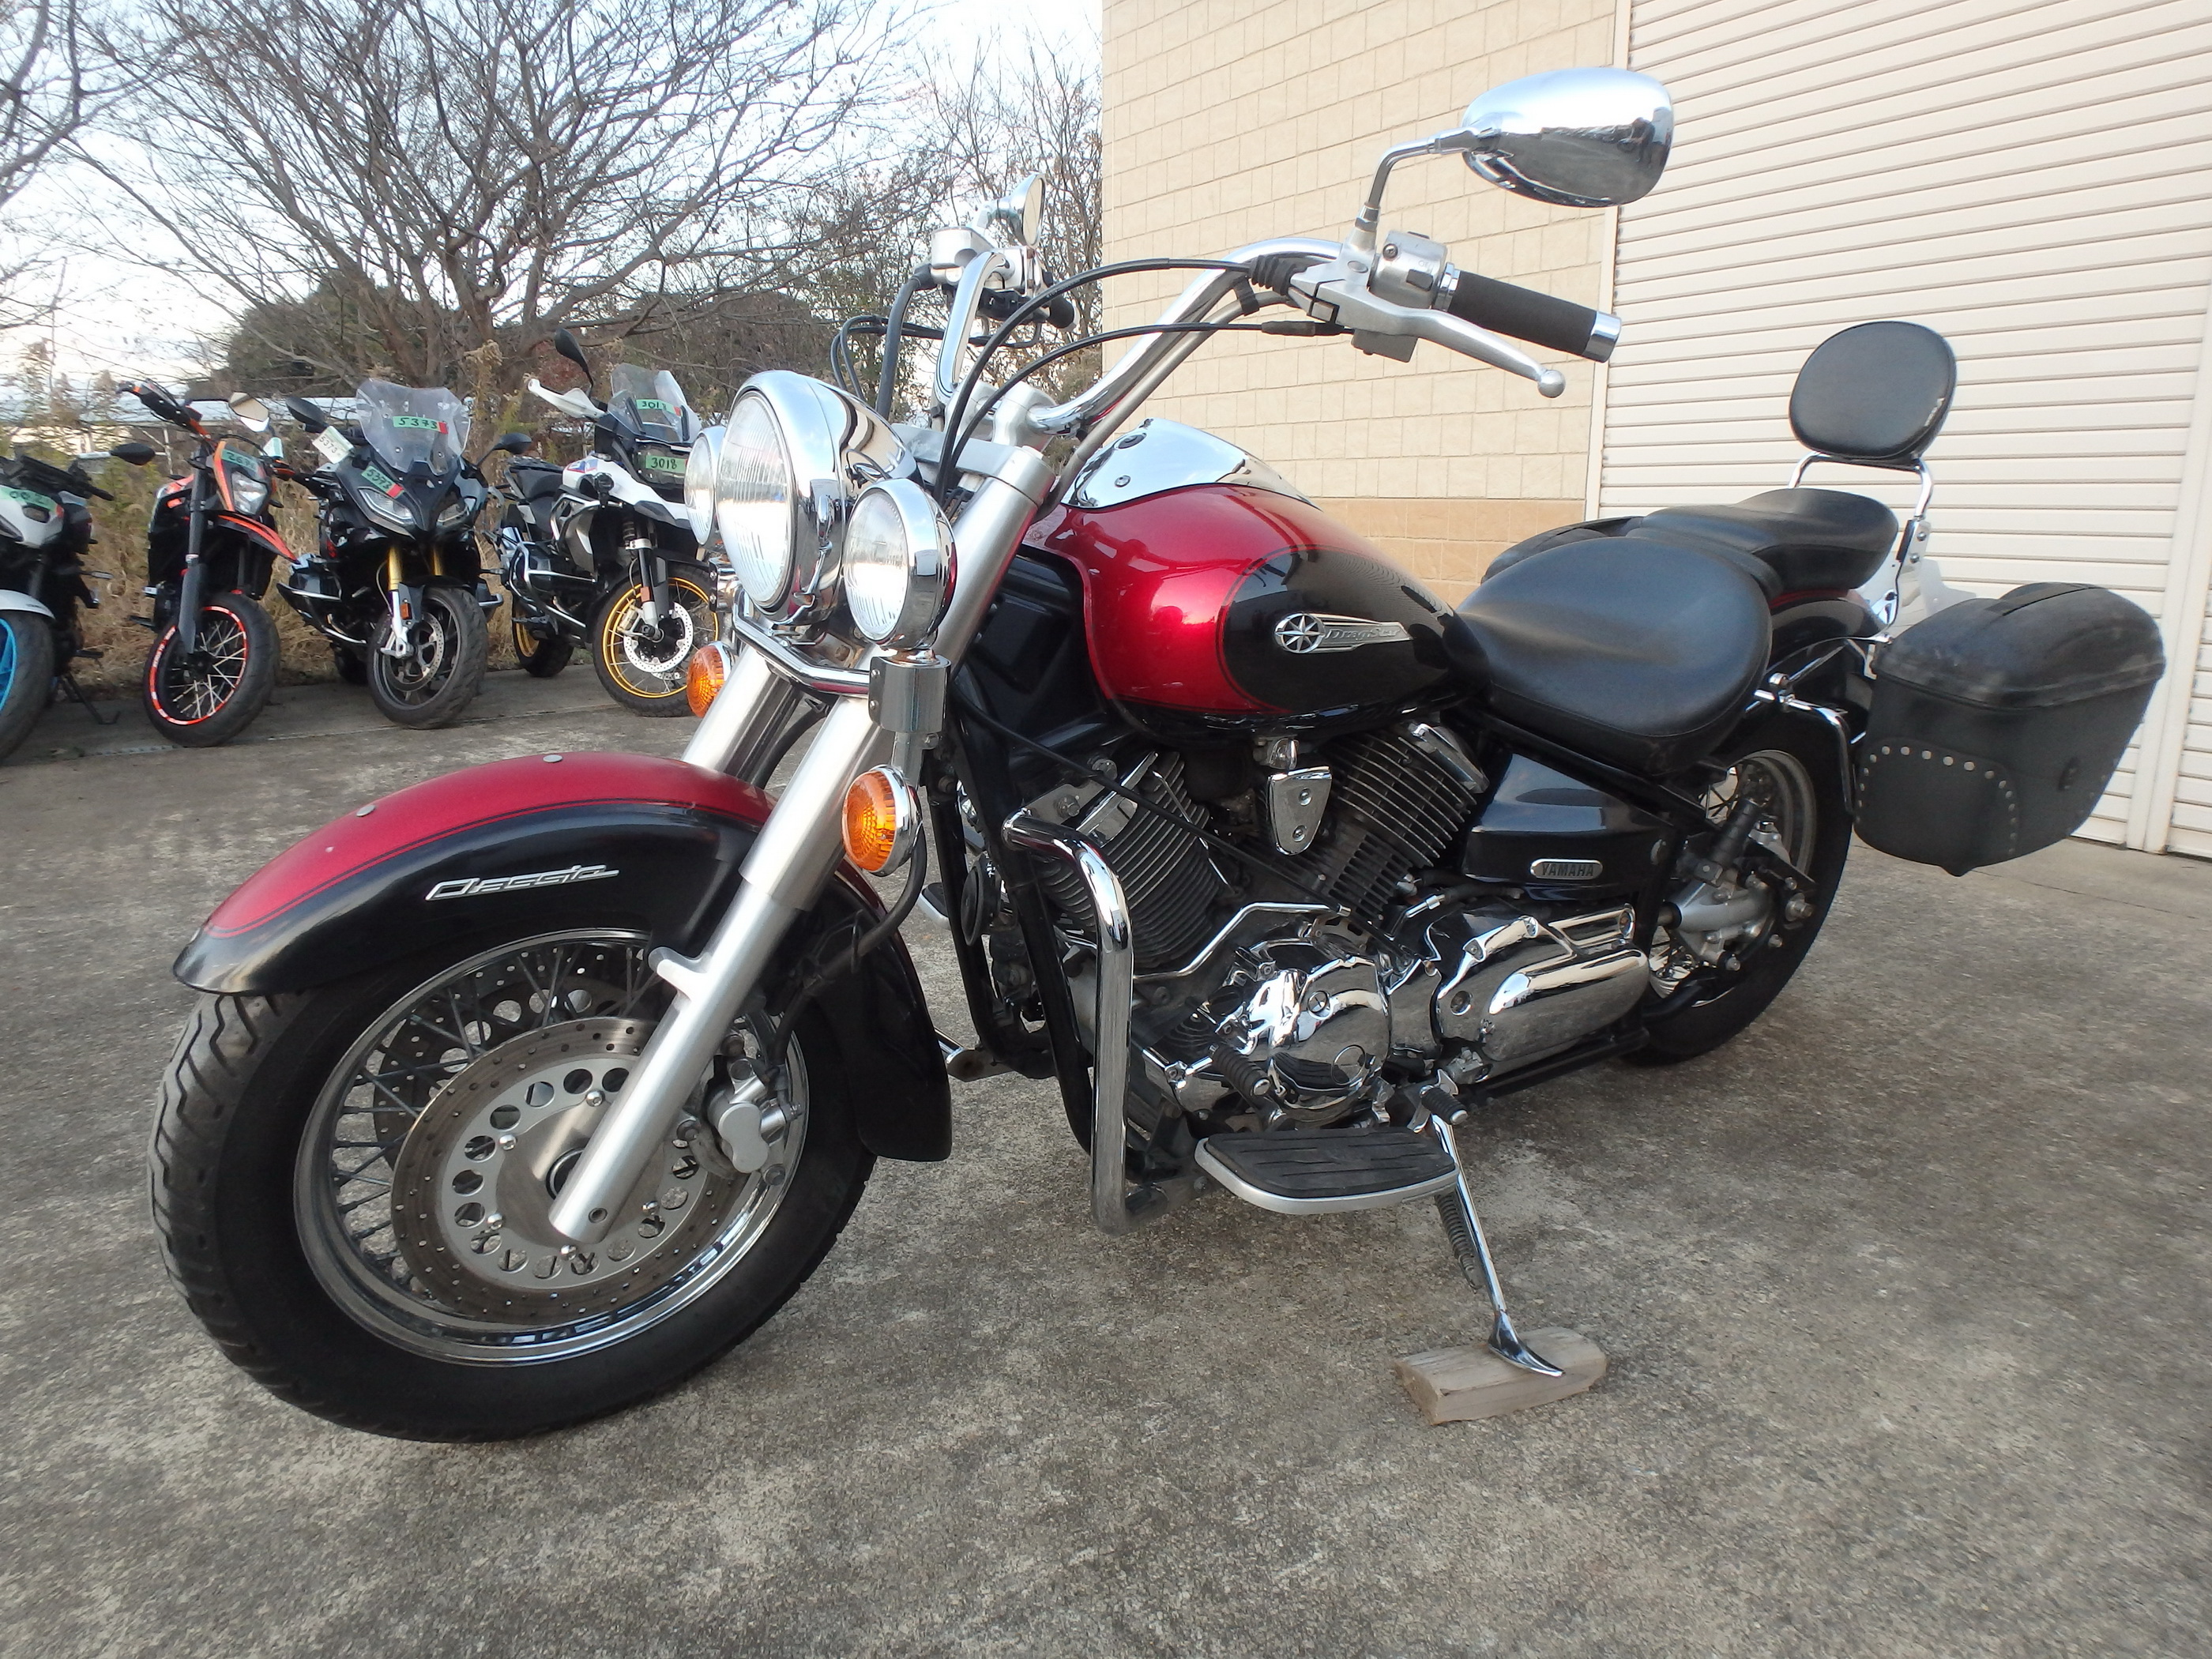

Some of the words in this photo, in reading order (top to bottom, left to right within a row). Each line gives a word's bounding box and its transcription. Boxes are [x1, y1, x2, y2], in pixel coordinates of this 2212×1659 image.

[398, 413, 438, 429] 5373
[319, 435, 338, 453] 5373
[650, 457, 678, 470] 3018
[367, 468, 393, 489] 5373
[1325, 626, 1401, 641] DragStar
[1540, 863, 1594, 877] YAMAHA
[424, 864, 620, 901] Classic
